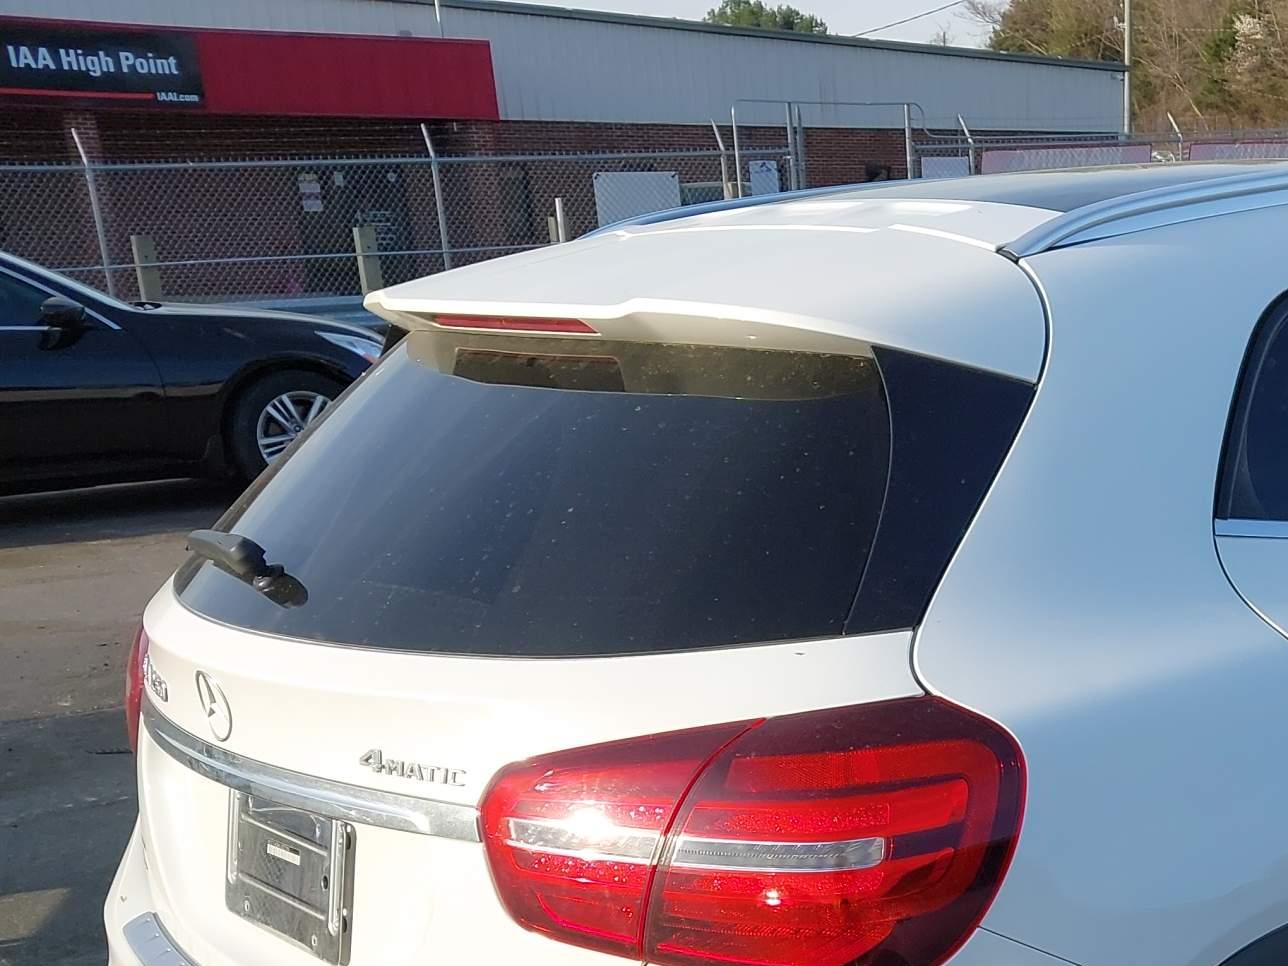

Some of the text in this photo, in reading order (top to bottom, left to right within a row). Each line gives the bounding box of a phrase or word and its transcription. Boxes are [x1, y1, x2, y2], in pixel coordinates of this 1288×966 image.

[7, 45, 179, 77] IAA High Point
